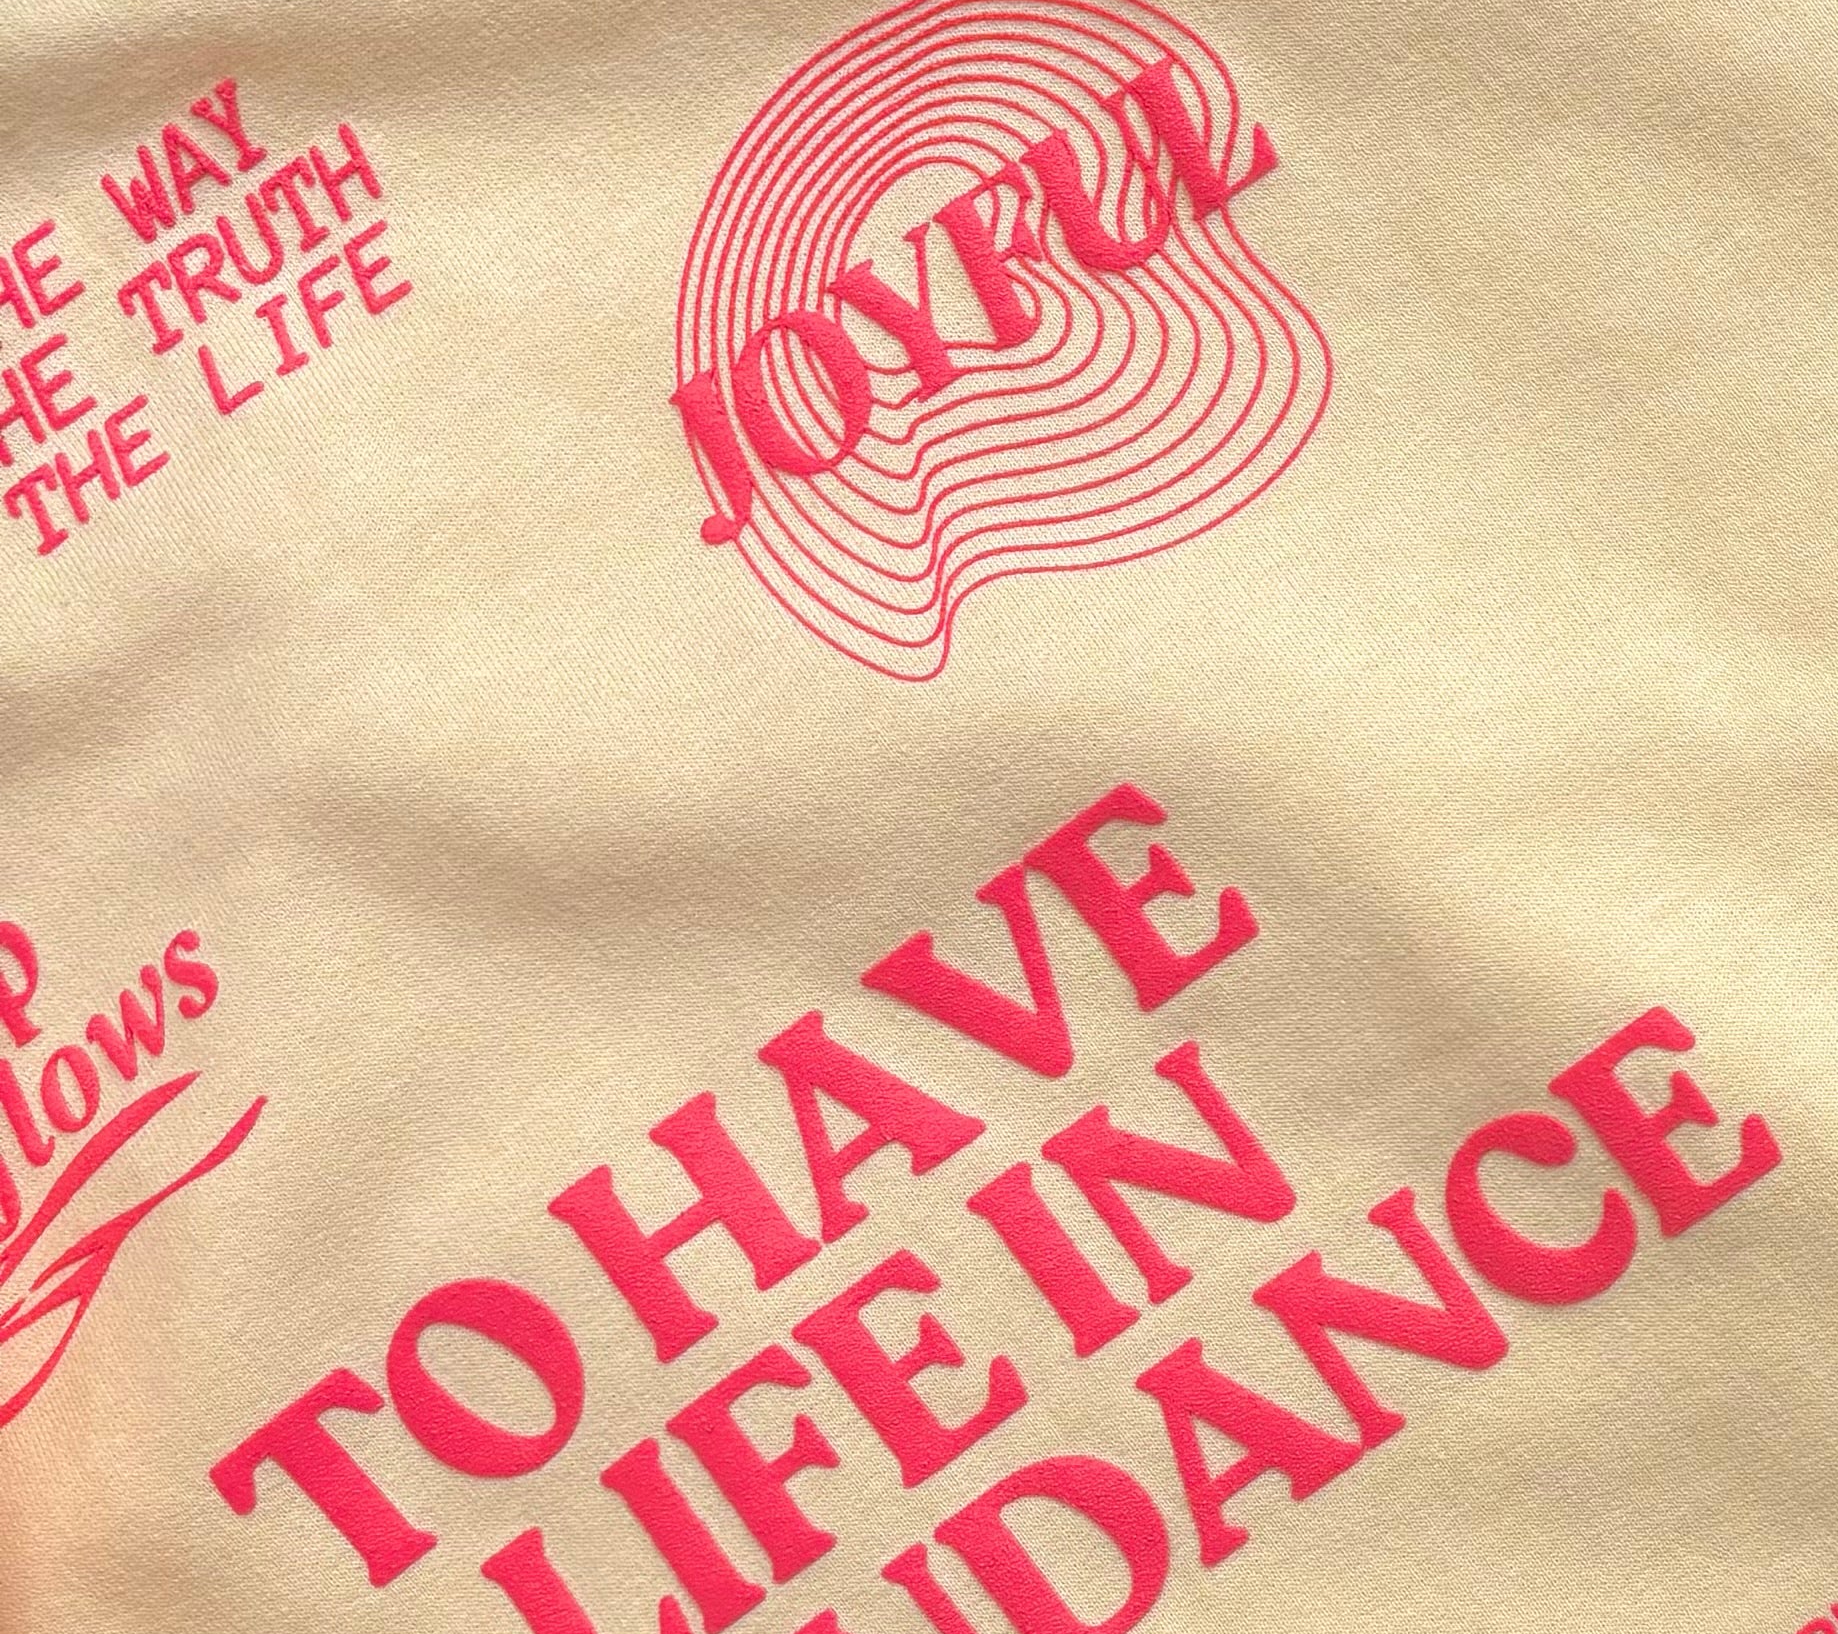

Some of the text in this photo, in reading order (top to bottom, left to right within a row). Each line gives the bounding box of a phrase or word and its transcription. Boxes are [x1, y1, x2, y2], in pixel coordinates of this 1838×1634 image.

[101, 78, 267, 243] WAY
[116, 123, 383, 355] TRUTH
[669, 54, 1278, 545] JOYFUL
[2, 220, 413, 556] THE LIFE
[210, 783, 1260, 1589] TO HAVE
[965, 1040, 1298, 1359] IN
